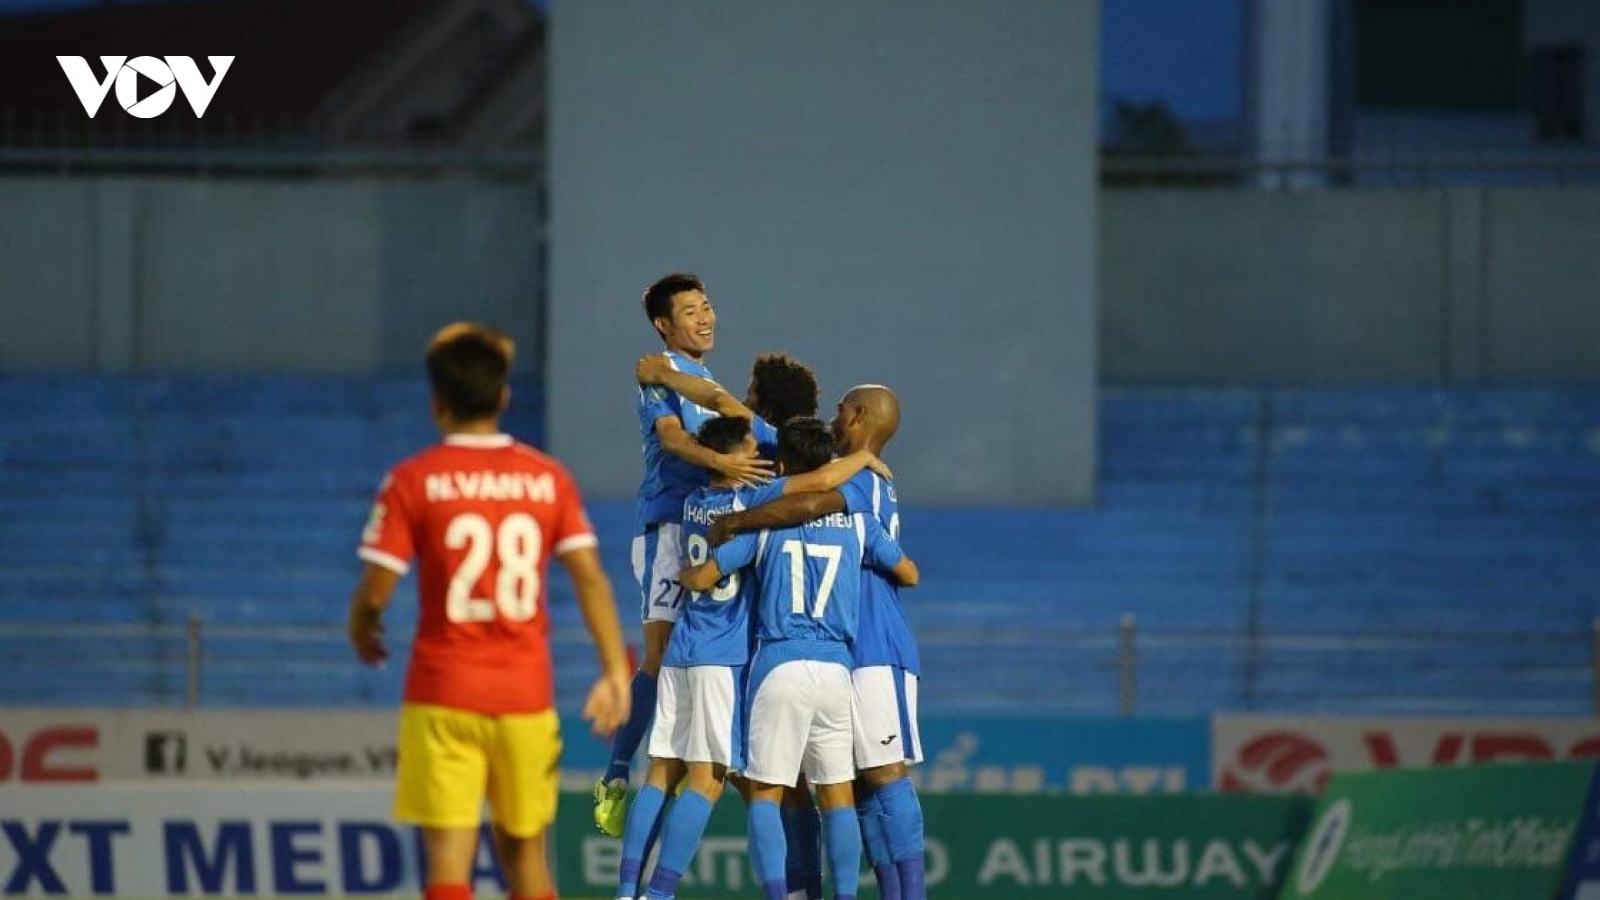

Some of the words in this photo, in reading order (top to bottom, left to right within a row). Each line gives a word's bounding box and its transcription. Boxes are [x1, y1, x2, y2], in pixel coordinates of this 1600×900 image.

[444, 512, 543, 624] 28
[653, 578, 685, 609] 27
[782, 540, 843, 618] 17
